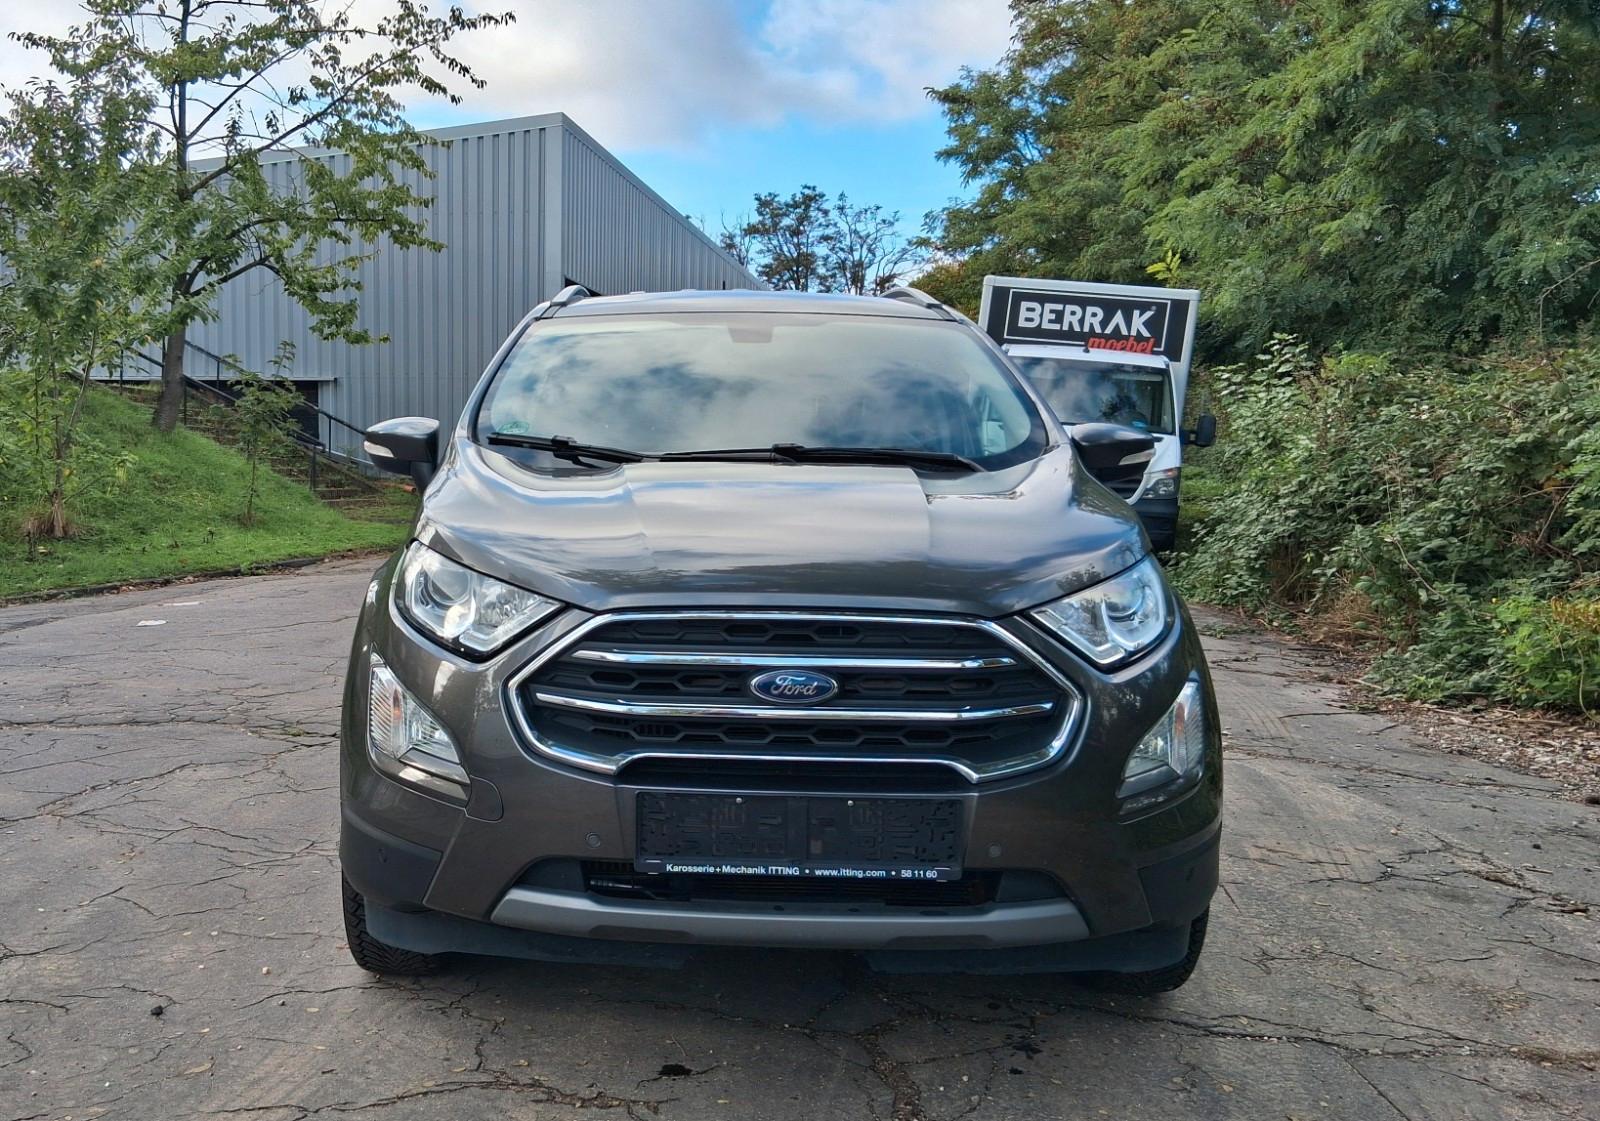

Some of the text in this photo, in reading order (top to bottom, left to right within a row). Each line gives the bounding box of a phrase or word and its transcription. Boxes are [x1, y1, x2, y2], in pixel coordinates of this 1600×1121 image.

[1017, 300, 1155, 338] BERRAK
[1087, 336, 1155, 355] moebel
[770, 675, 818, 696] Ford
[768, 866, 800, 876] ITTING
[814, 867, 886, 878] www.itting.com
[900, 869, 912, 878] 58
